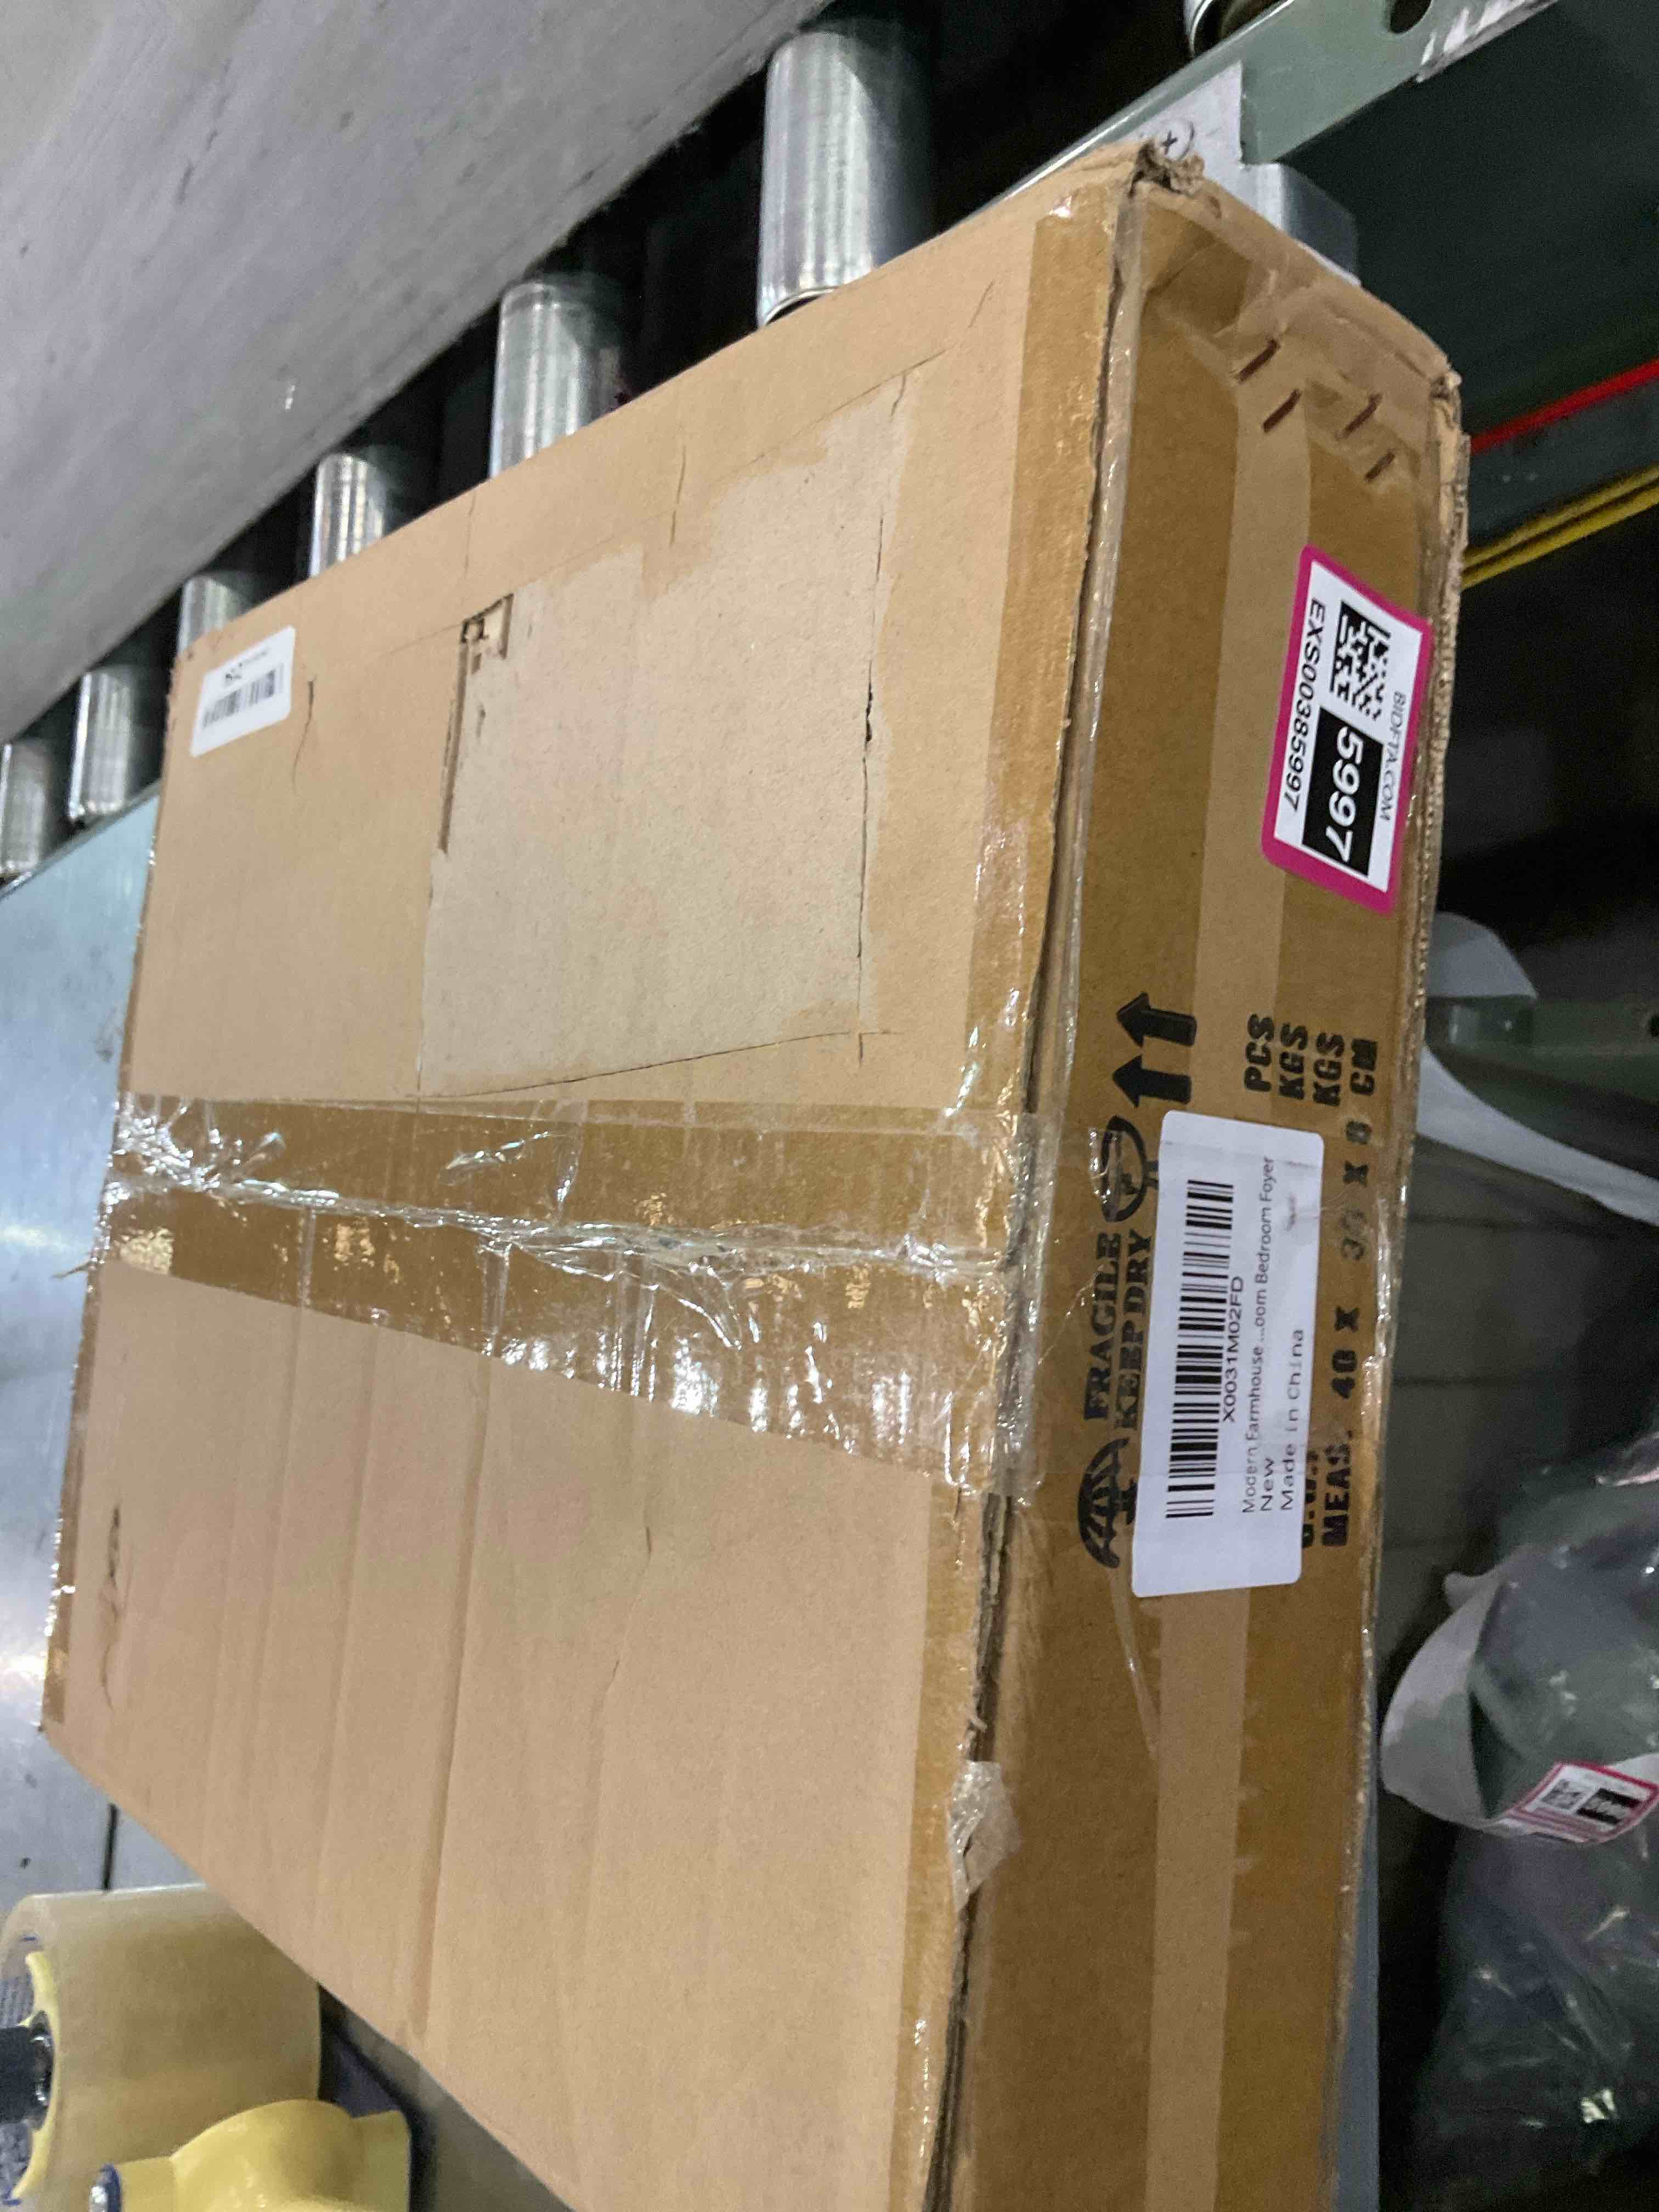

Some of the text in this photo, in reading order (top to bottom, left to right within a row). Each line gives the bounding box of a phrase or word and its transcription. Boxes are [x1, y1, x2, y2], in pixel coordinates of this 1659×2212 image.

[1284, 599, 1325, 812] EXS00385997
[1325, 726, 1364, 863] 5997
[1379, 690, 1407, 821] BIDFTA.COM
[1244, 1013, 1274, 1092] PCS
[1278, 1023, 1308, 1101] KGS
[1312, 1031, 1345, 1107] KGS
[1349, 1039, 1378, 1097] CM
[1259, 1156, 1278, 1203] Foyer
[1254, 1209, 1272, 1284] Bedroom
[1083, 1232, 1121, 1421] FRAGILE
[1114, 1228, 1152, 1429] KEEP DRY
[1221, 1276, 1244, 1423] X0031M02FD
[1245, 1346, 1262, 1441] Farmhouse
[1280, 1329, 1305, 1510] Made in China
[1242, 1443, 1259, 1513] Modern
[1259, 1457, 1276, 1511] New
